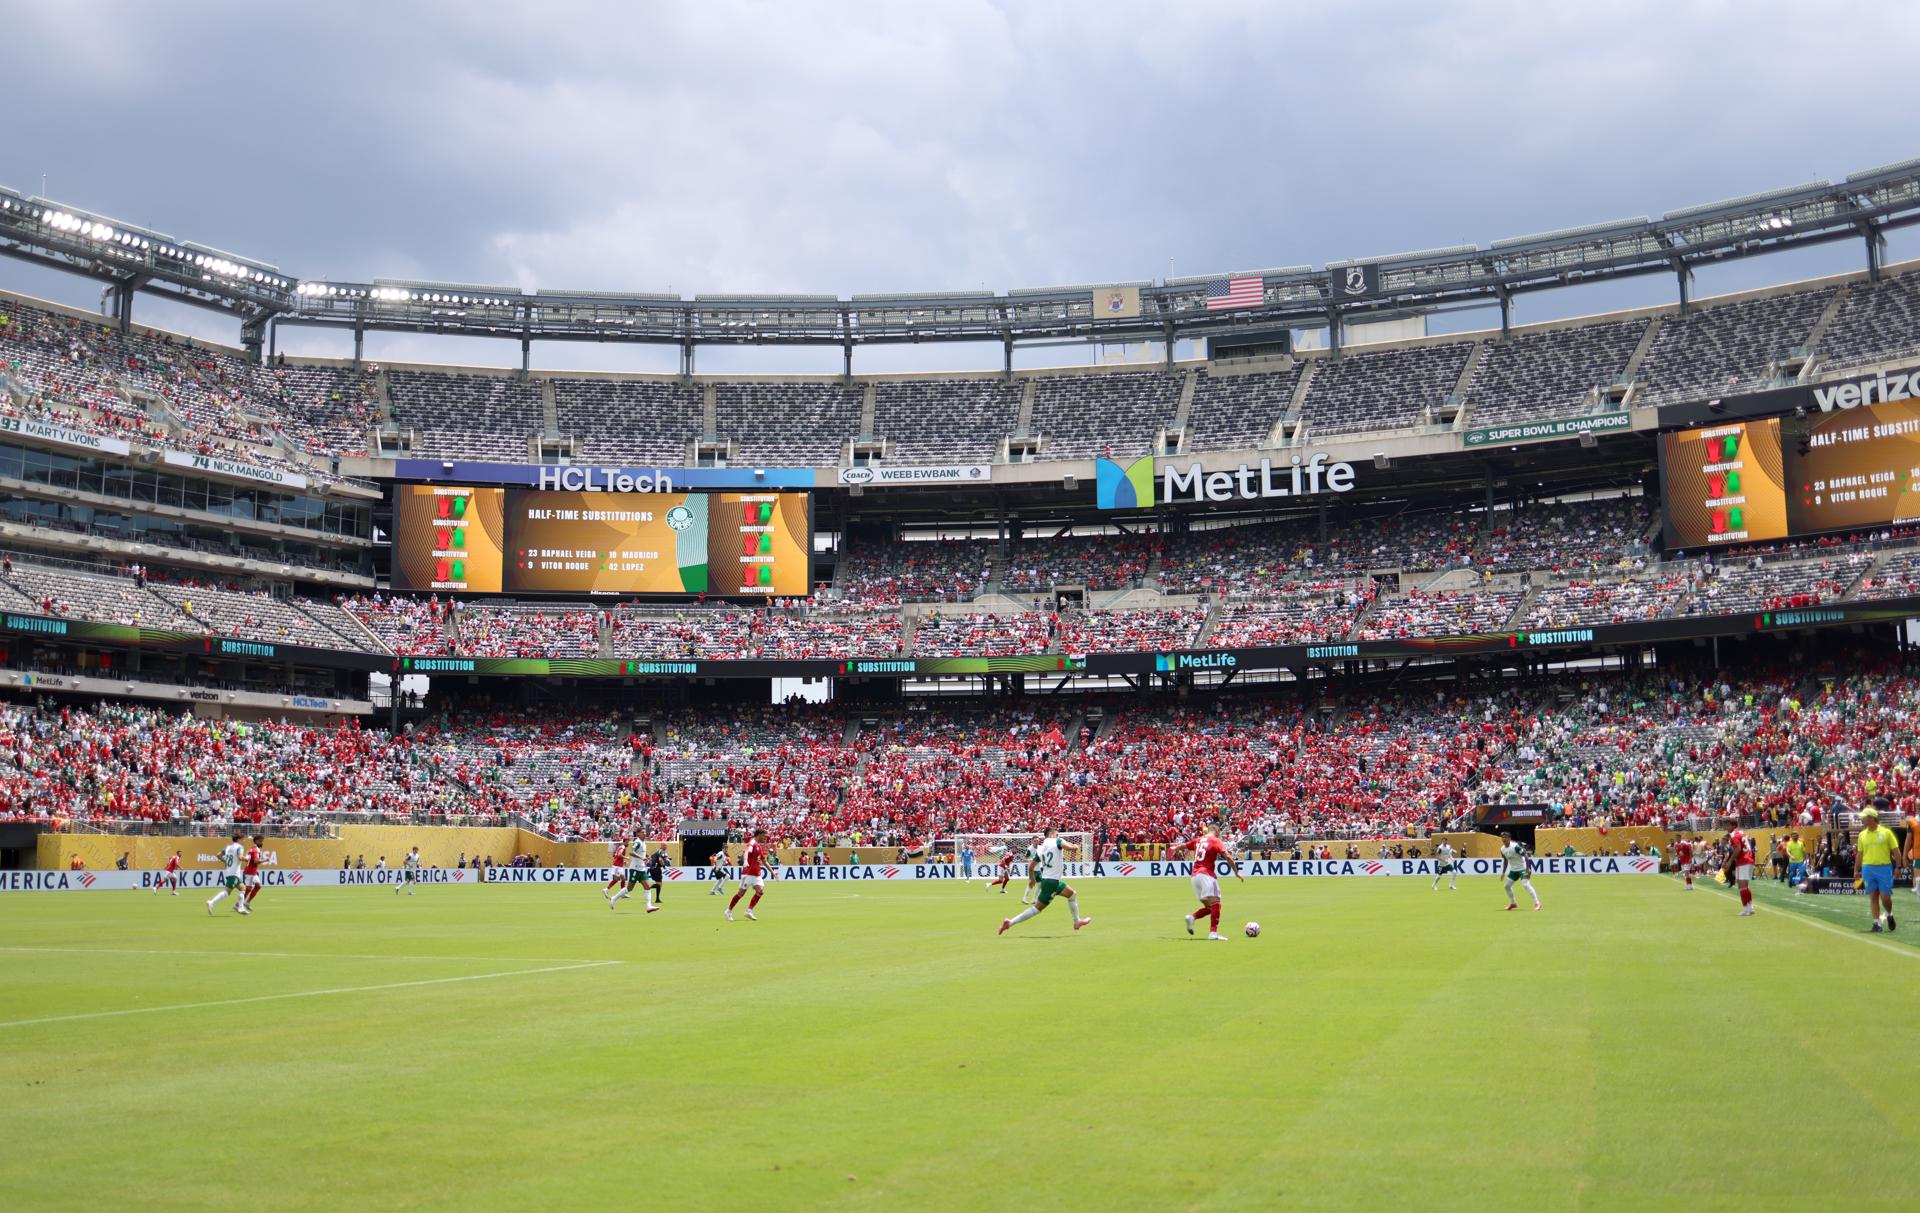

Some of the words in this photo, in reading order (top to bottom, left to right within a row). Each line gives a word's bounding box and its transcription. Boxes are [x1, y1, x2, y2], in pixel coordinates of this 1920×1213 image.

[1, 416, 20, 431] 93
[25, 423, 67, 440] MARTY
[68, 431, 101, 447] LYONS
[1488, 429, 1521, 441] SUPER
[1523, 425, 1556, 436] BOWL
[1566, 415, 1628, 432] CHAMPIONS
[1809, 427, 1870, 447] HALF-TIME
[192, 455, 210, 469] 74
[213, 460, 235, 474] NICK
[236, 465, 283, 482] MANGOLD
[881, 470, 913, 480] WEEB
[914, 469, 960, 479] EWBANK
[539, 466, 672, 494] HCLTech
[1163, 452, 1355, 504] MetLife
[1814, 481, 1825, 490] 23
[1829, 476, 1867, 489] RAPHAEL
[1869, 471, 1896, 484] VEIGA
[1830, 491, 1856, 504] VITOR
[1859, 488, 1888, 500] ROQUE
[528, 509, 579, 520] HALF-TIME
[582, 511, 653, 522] SUBSTITUTIONS
[528, 549, 538, 558] 23
[541, 549, 573, 558] RAPHAEL
[528, 561, 534, 569] 9
[541, 562, 563, 570] VITOR
[7, 616, 67, 635] SUBSTITUTION
[1775, 610, 1845, 626] SUBSTITUTION
[1528, 629, 1593, 645] SUBSTITUTION
[221, 640, 275, 657] SUBSTITUTION
[414, 658, 474, 671] SUBSTITUTION
[638, 661, 698, 674] SUBSTITUTION
[857, 661, 916, 673] SUBSTITUTION
[1180, 653, 1236, 668] MetLife
[36, 675, 64, 687] MetLife
[189, 690, 219, 701] verizon
[292, 697, 328, 709] HCLTech
[1041, 851, 1054, 869] 12
[1150, 862, 1193, 876] BAN
[1250, 860, 1355, 875] AMERICA
[1473, 859, 1502, 874] OF
[1529, 856, 1620, 874] MERICA
[193, 871, 213, 887] OF
[339, 869, 374, 885] BANK
[377, 870, 393, 884] OF
[396, 868, 448, 883] AERICA
[488, 868, 537, 881] BANK
[542, 868, 565, 882] OF
[784, 865, 875, 880] AMERICA
